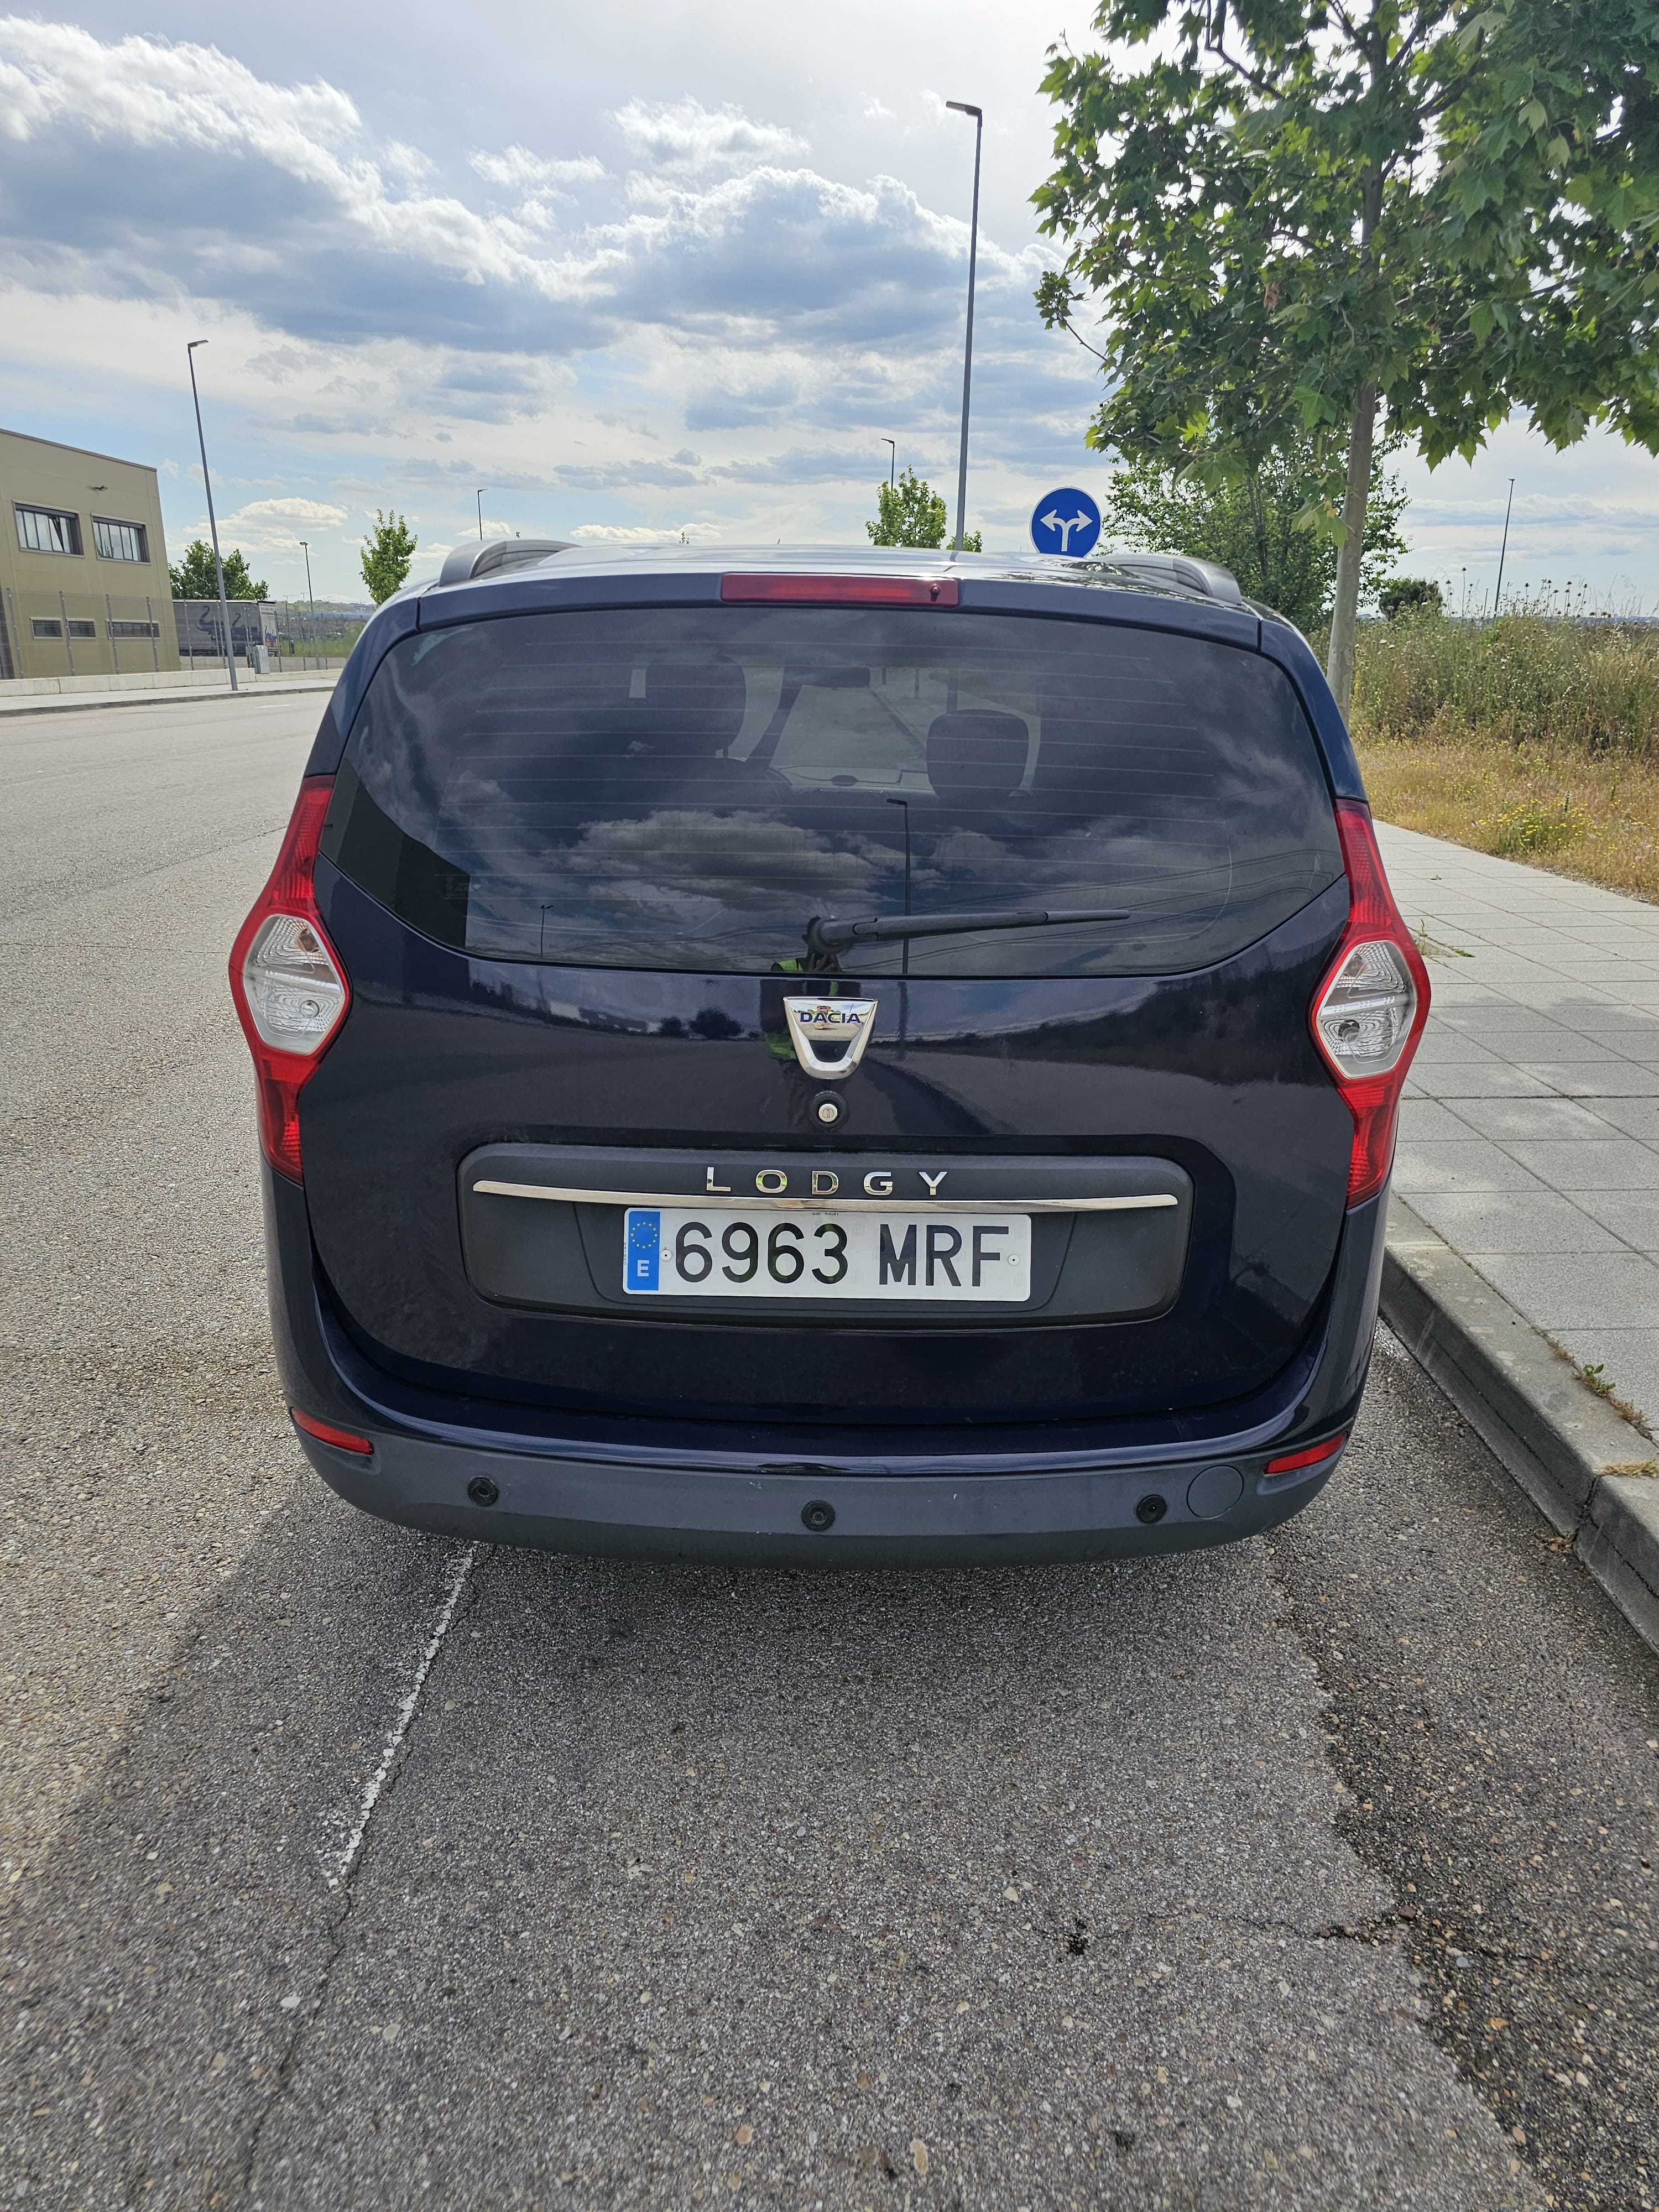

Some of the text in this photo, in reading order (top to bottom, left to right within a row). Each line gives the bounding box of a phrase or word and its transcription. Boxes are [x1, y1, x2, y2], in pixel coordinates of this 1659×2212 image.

[800, 1012, 861, 1024] DACIA
[706, 1167, 947, 1196] LODGY
[676, 1222, 1009, 1287] 6963 MRF
[637, 1260, 649, 1276] E
